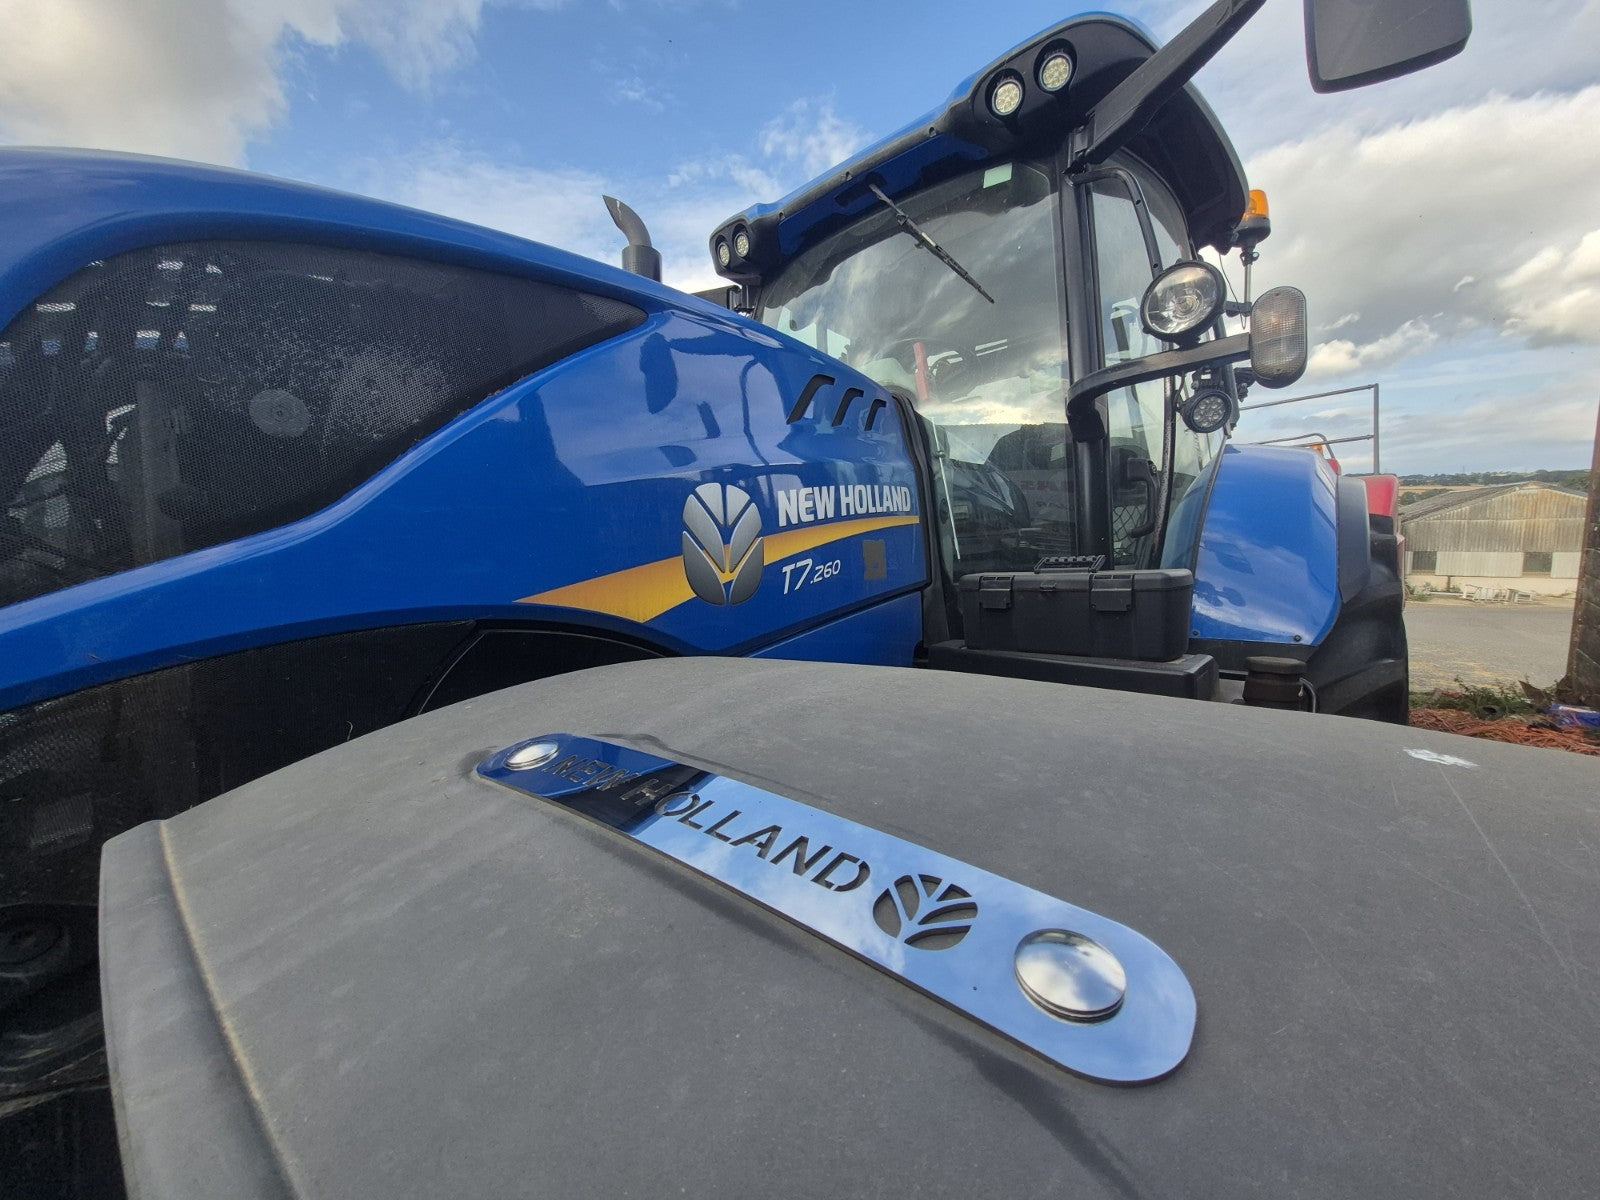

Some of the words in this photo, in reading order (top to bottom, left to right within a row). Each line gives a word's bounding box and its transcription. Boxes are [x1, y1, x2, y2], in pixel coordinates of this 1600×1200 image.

[777, 485, 836, 528] NEW
[840, 484, 911, 517] HOLLAND
[782, 558, 841, 595] T7.260
[542, 755, 642, 792] NEW
[619, 778, 871, 893] HOLLAND
